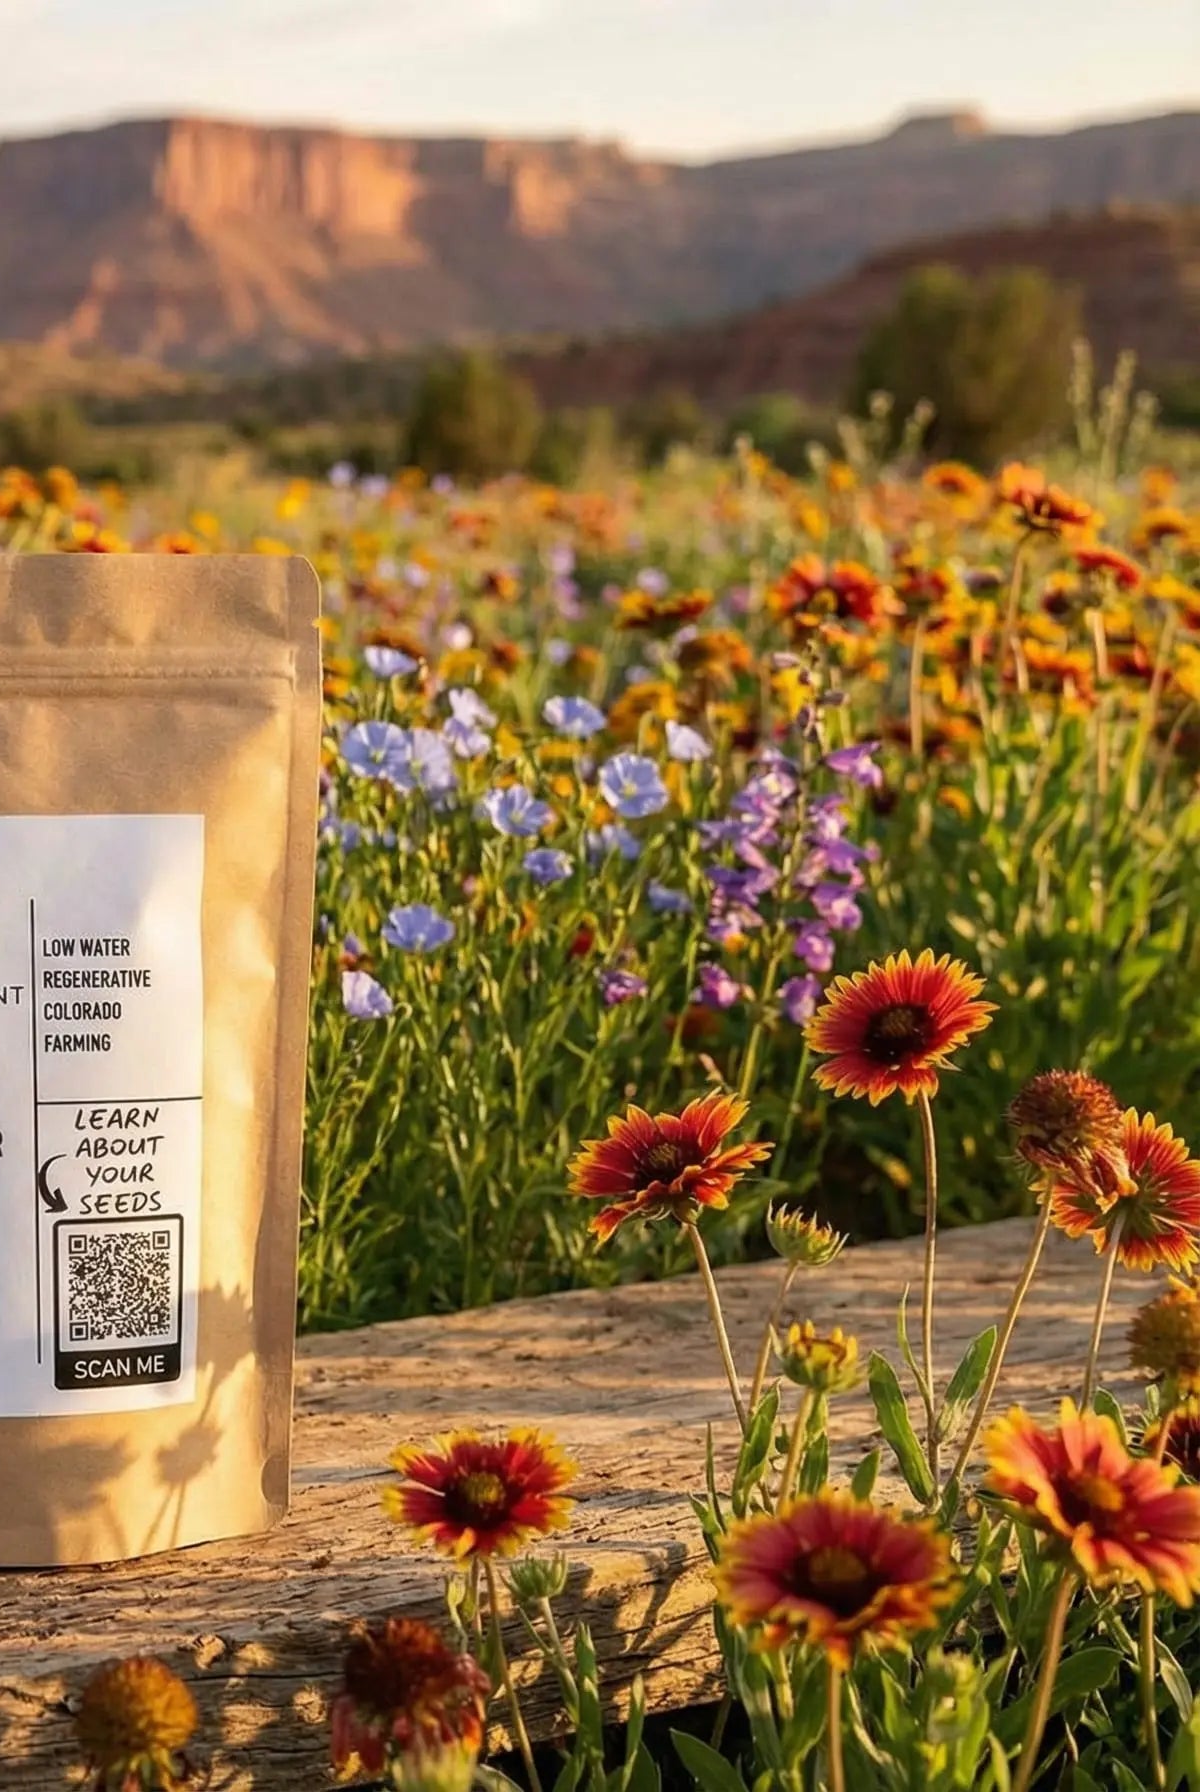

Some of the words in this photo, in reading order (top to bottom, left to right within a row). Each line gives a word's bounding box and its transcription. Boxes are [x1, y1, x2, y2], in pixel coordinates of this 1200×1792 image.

[42, 938, 76, 958] LOW
[79, 938, 131, 957] WATER
[43, 969, 151, 989] REGENERATIVE
[43, 1001, 122, 1021] COLORADO
[44, 1033, 111, 1053] FARMING
[74, 1107, 160, 1131] LEARN
[75, 1135, 165, 1159] ABOUT
[85, 1162, 155, 1187] YOUR
[79, 1190, 162, 1215] SEEDS
[74, 1357, 131, 1379] SCAN
[137, 1354, 165, 1375] ME
